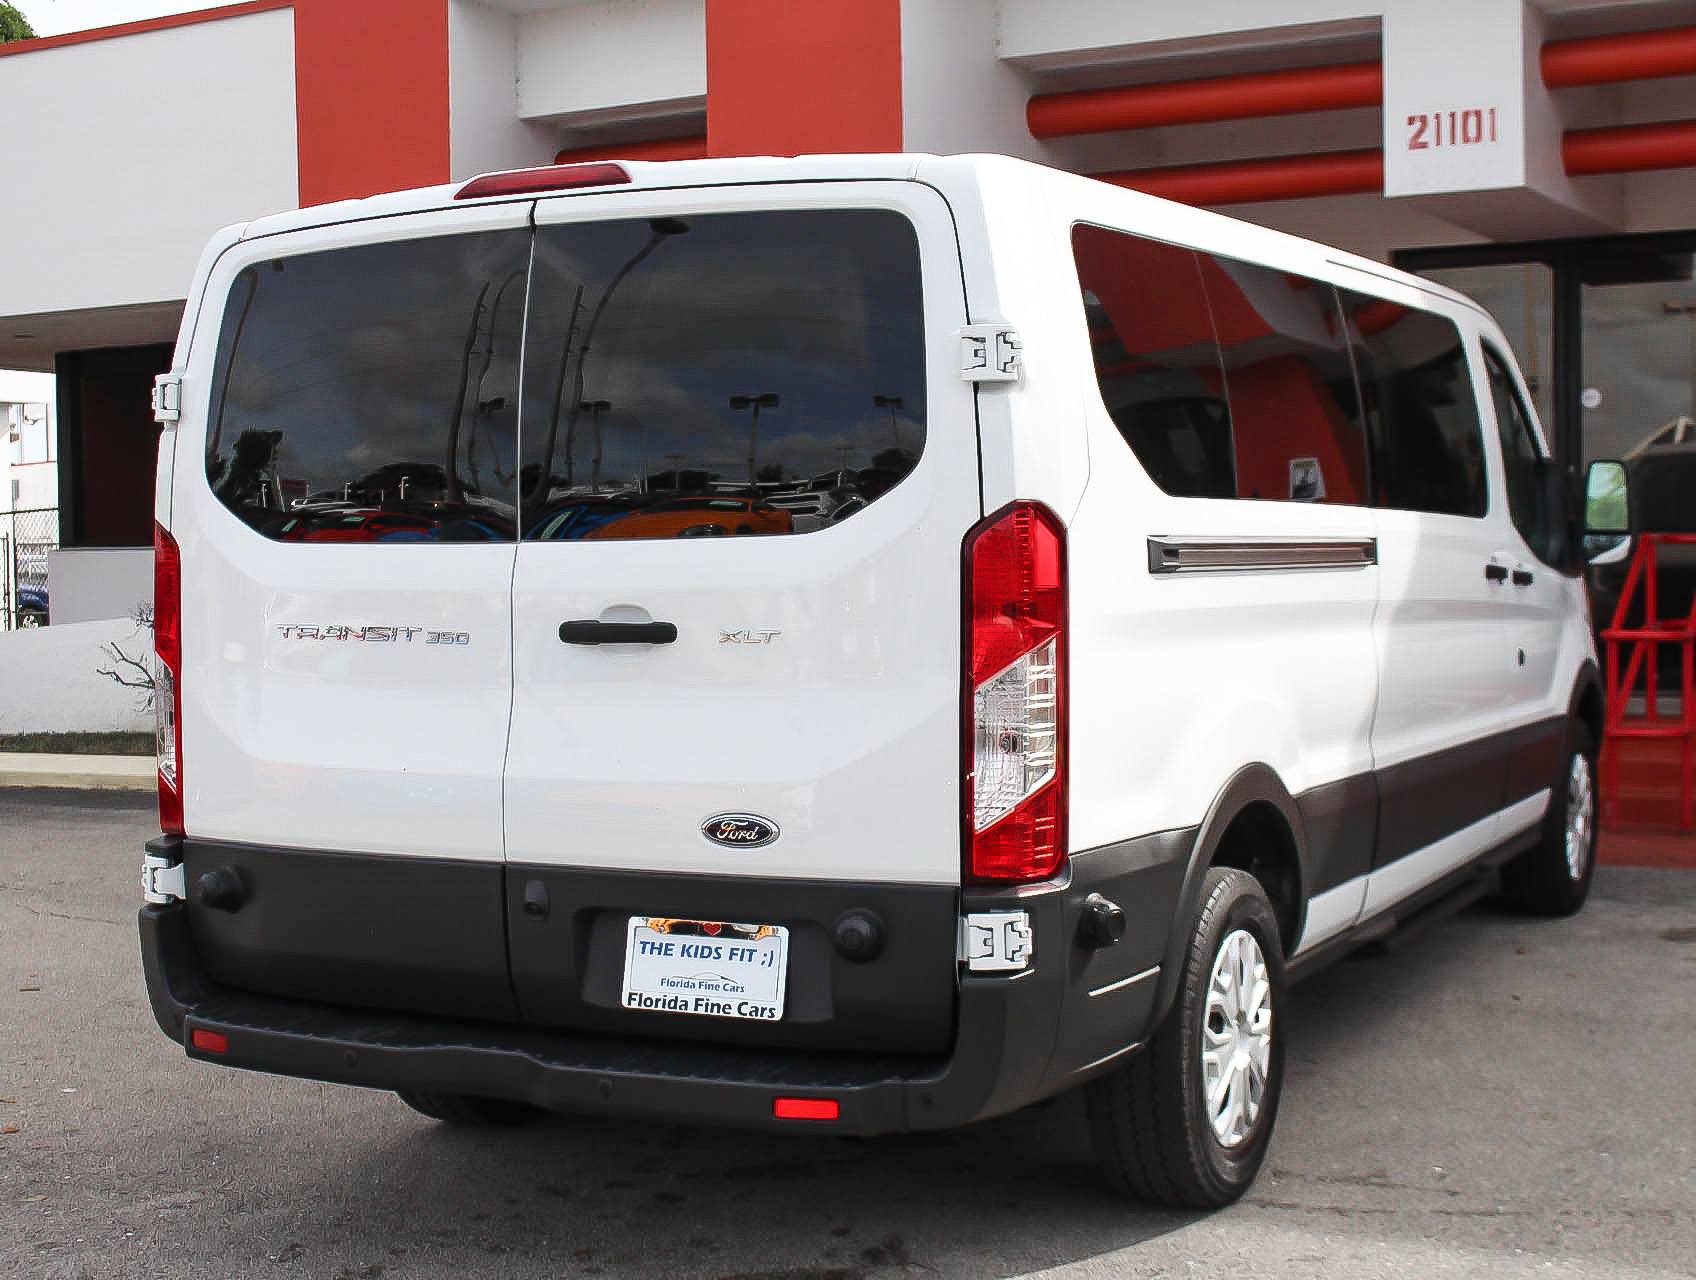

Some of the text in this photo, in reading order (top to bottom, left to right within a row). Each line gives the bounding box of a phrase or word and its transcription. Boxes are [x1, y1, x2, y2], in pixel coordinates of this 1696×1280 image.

[1407, 107, 1497, 150] 21101
[277, 624, 469, 645] TRANSIT 350
[719, 629, 782, 644] XLT
[716, 820, 760, 840] Ford
[639, 940, 675, 957] THE
[680, 943, 722, 960] KIDS
[728, 947, 757, 963] FIT
[660, 977, 745, 993] Florida Fine Cars
[627, 992, 776, 1019] Florida Fine Cars
